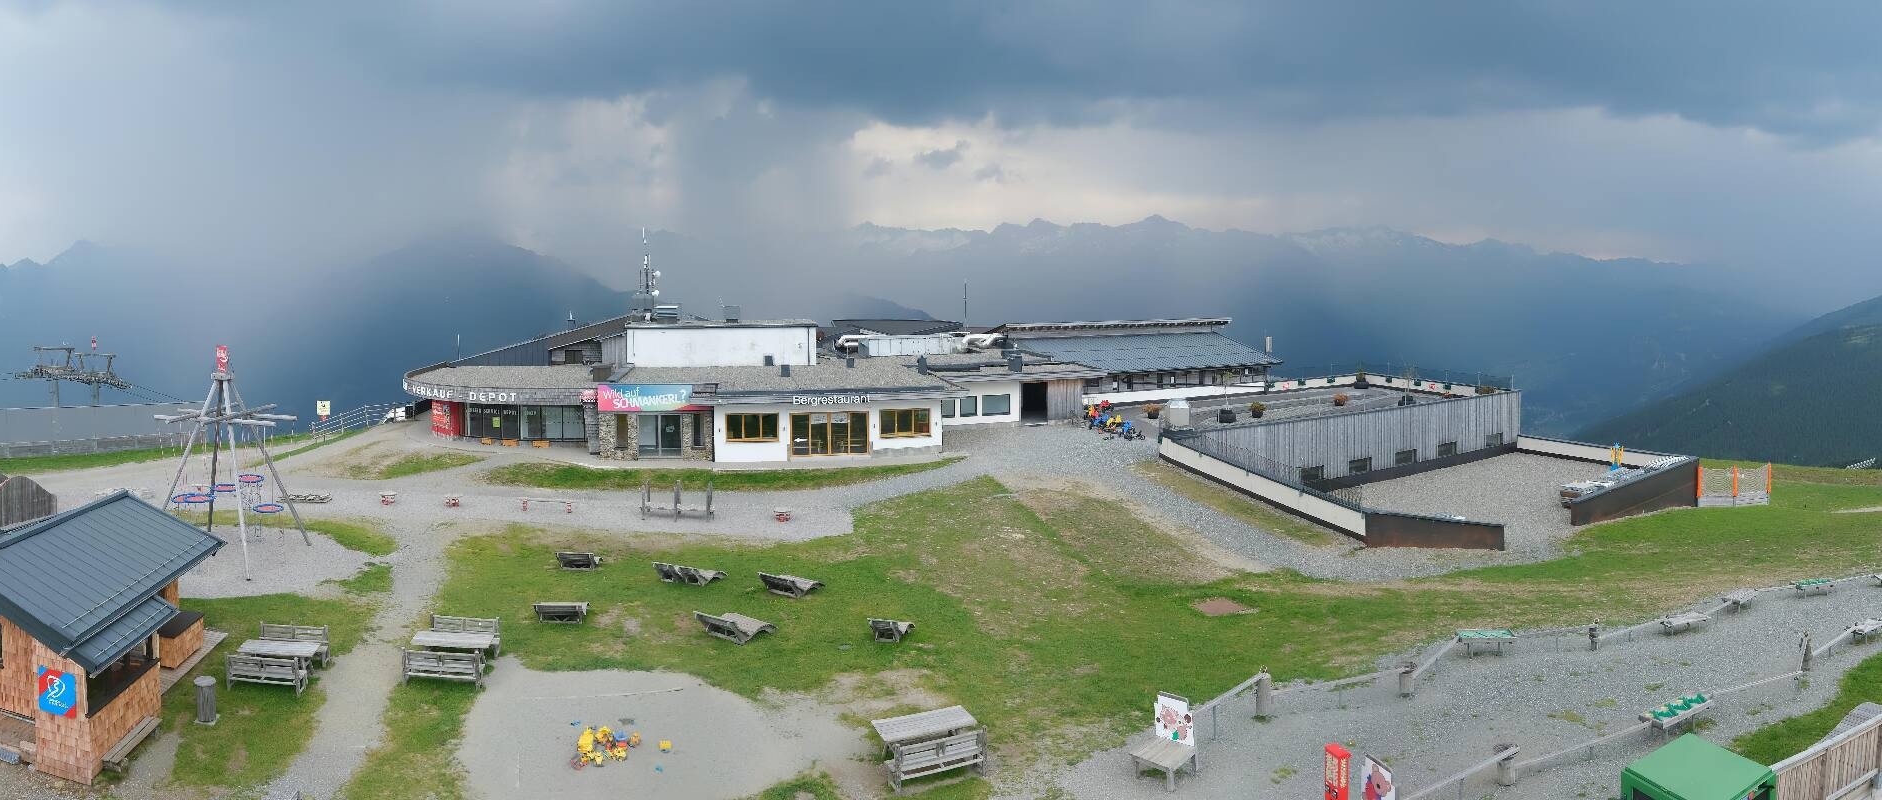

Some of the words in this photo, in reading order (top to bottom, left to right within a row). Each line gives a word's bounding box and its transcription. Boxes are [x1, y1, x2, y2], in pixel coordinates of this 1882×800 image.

[412, 385, 453, 399] VERKAUF
[469, 392, 517, 402] DEPOT
[603, 389, 623, 399] Wild
[625, 386, 640, 397] auf
[613, 389, 687, 409] SCHMANKERL?
[792, 394, 871, 407] Bergrestaurant
